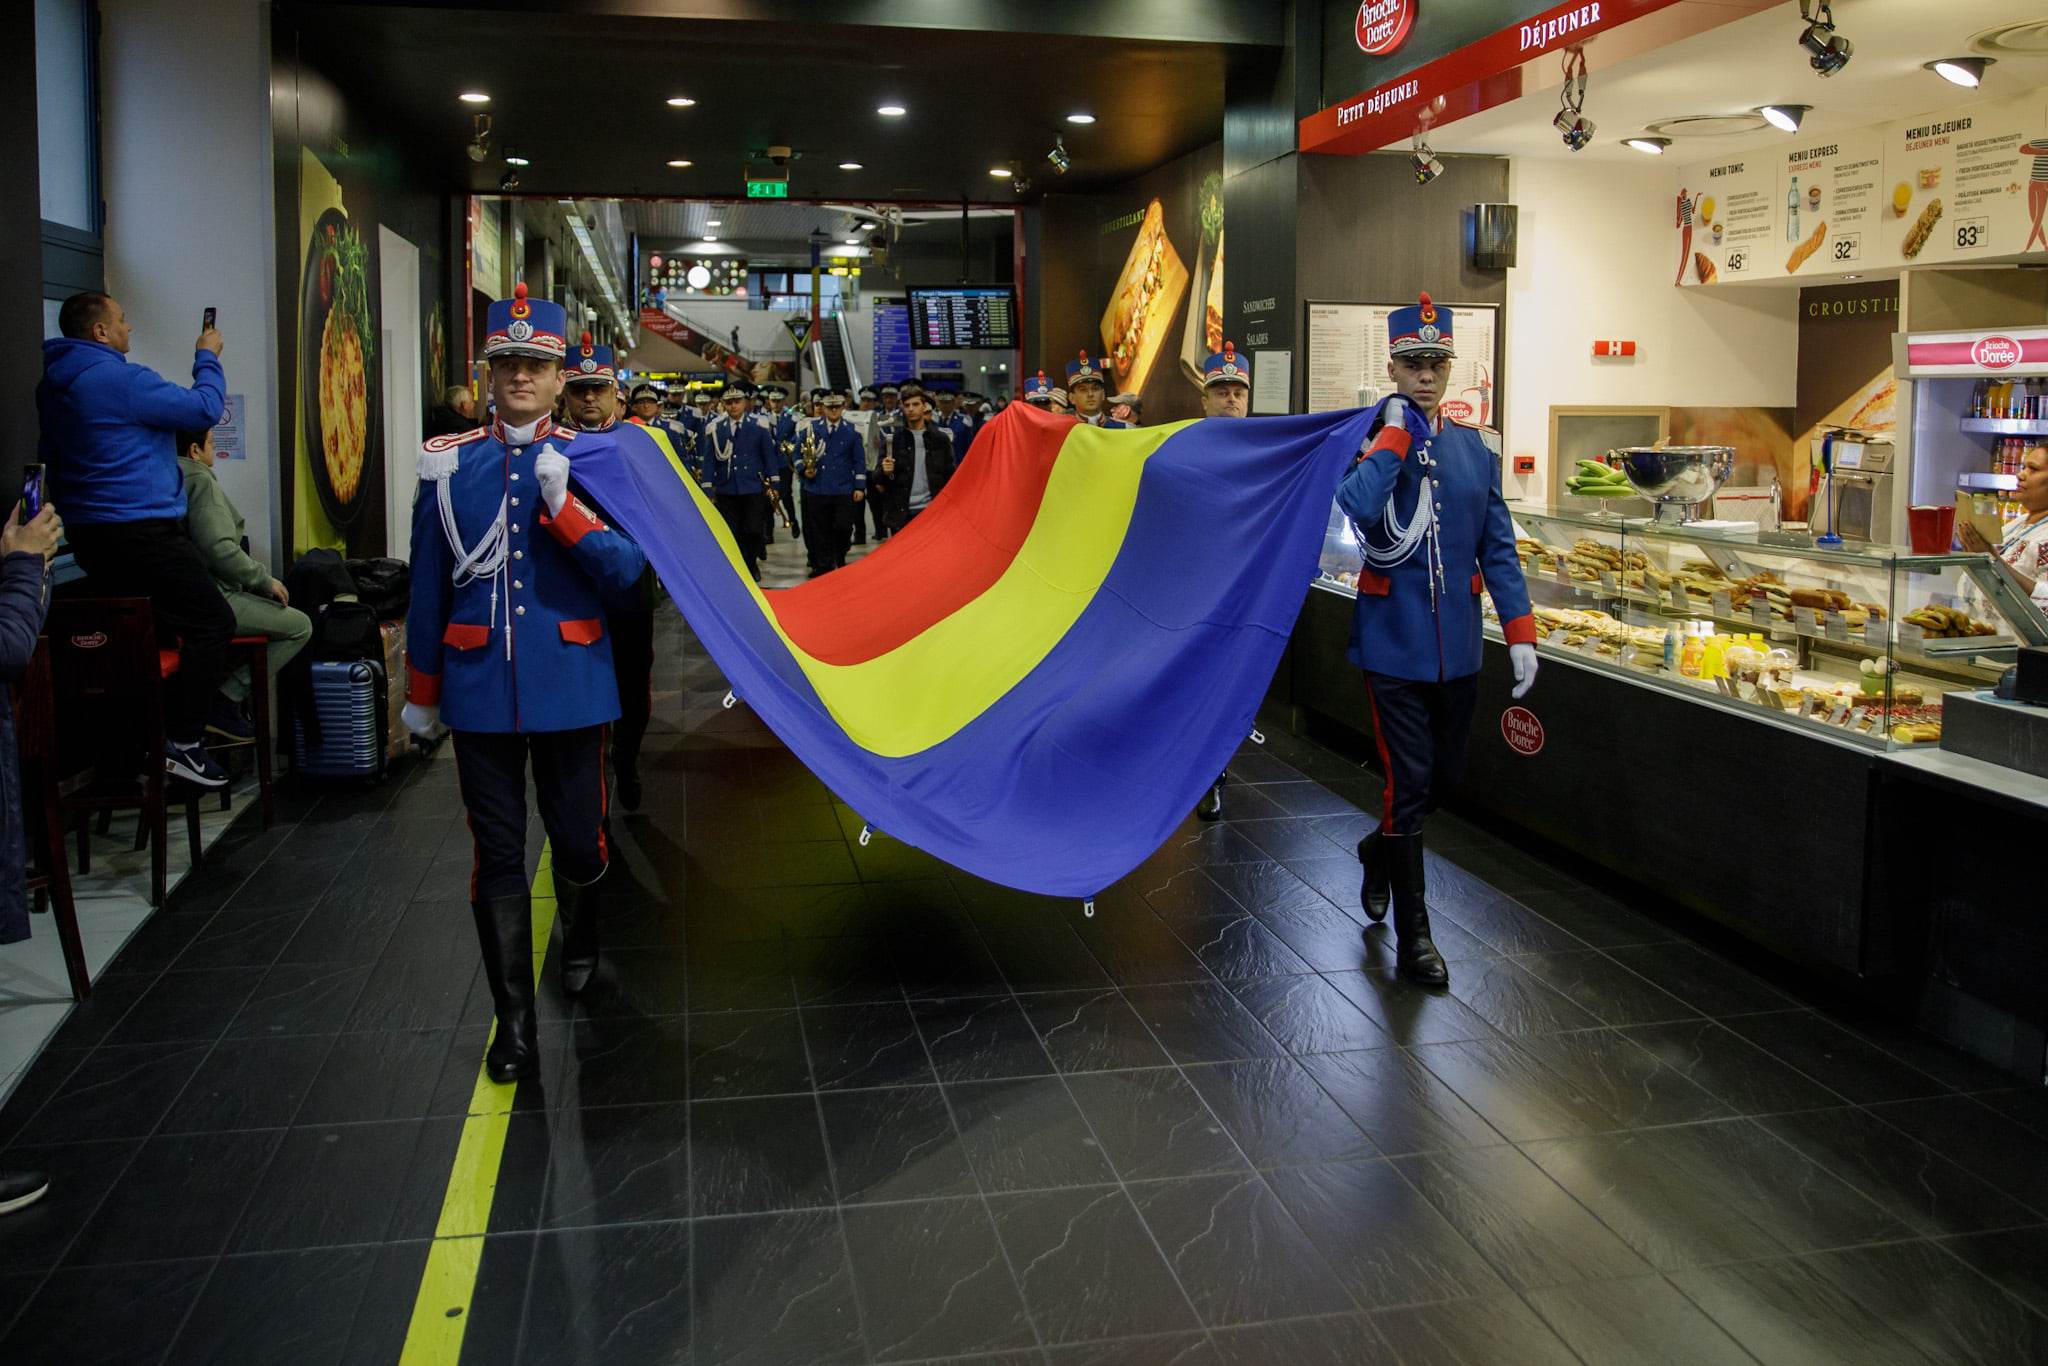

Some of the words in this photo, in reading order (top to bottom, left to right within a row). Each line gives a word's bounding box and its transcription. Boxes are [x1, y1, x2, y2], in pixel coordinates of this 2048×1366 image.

[1366, 17, 1394, 46] Dorée
[1520, 2, 1600, 51] DÉJEUNER
[1337, 102, 1365, 127] PETIT
[1367, 80, 1419, 114] DÉJEUNER
[1905, 126, 1930, 140] MENIU
[1931, 118, 1972, 136] DEJEUNER
[1934, 136, 1950, 147] MENU
[1788, 150, 1809, 163] MENIU
[1809, 144, 1838, 159] EXPRESS
[1709, 165, 1727, 178] MENIU
[1728, 162, 1744, 175] TONIC
[1956, 225, 1978, 247] 83
[1834, 241, 1851, 259] 32
[1727, 254, 1742, 270] 48
[1808, 297, 1899, 317] CROUSTIL
[1980, 349, 2015, 363] Dorée
[1442, 407, 1470, 417] Dorée
[1507, 711, 1539, 738] Brioche
